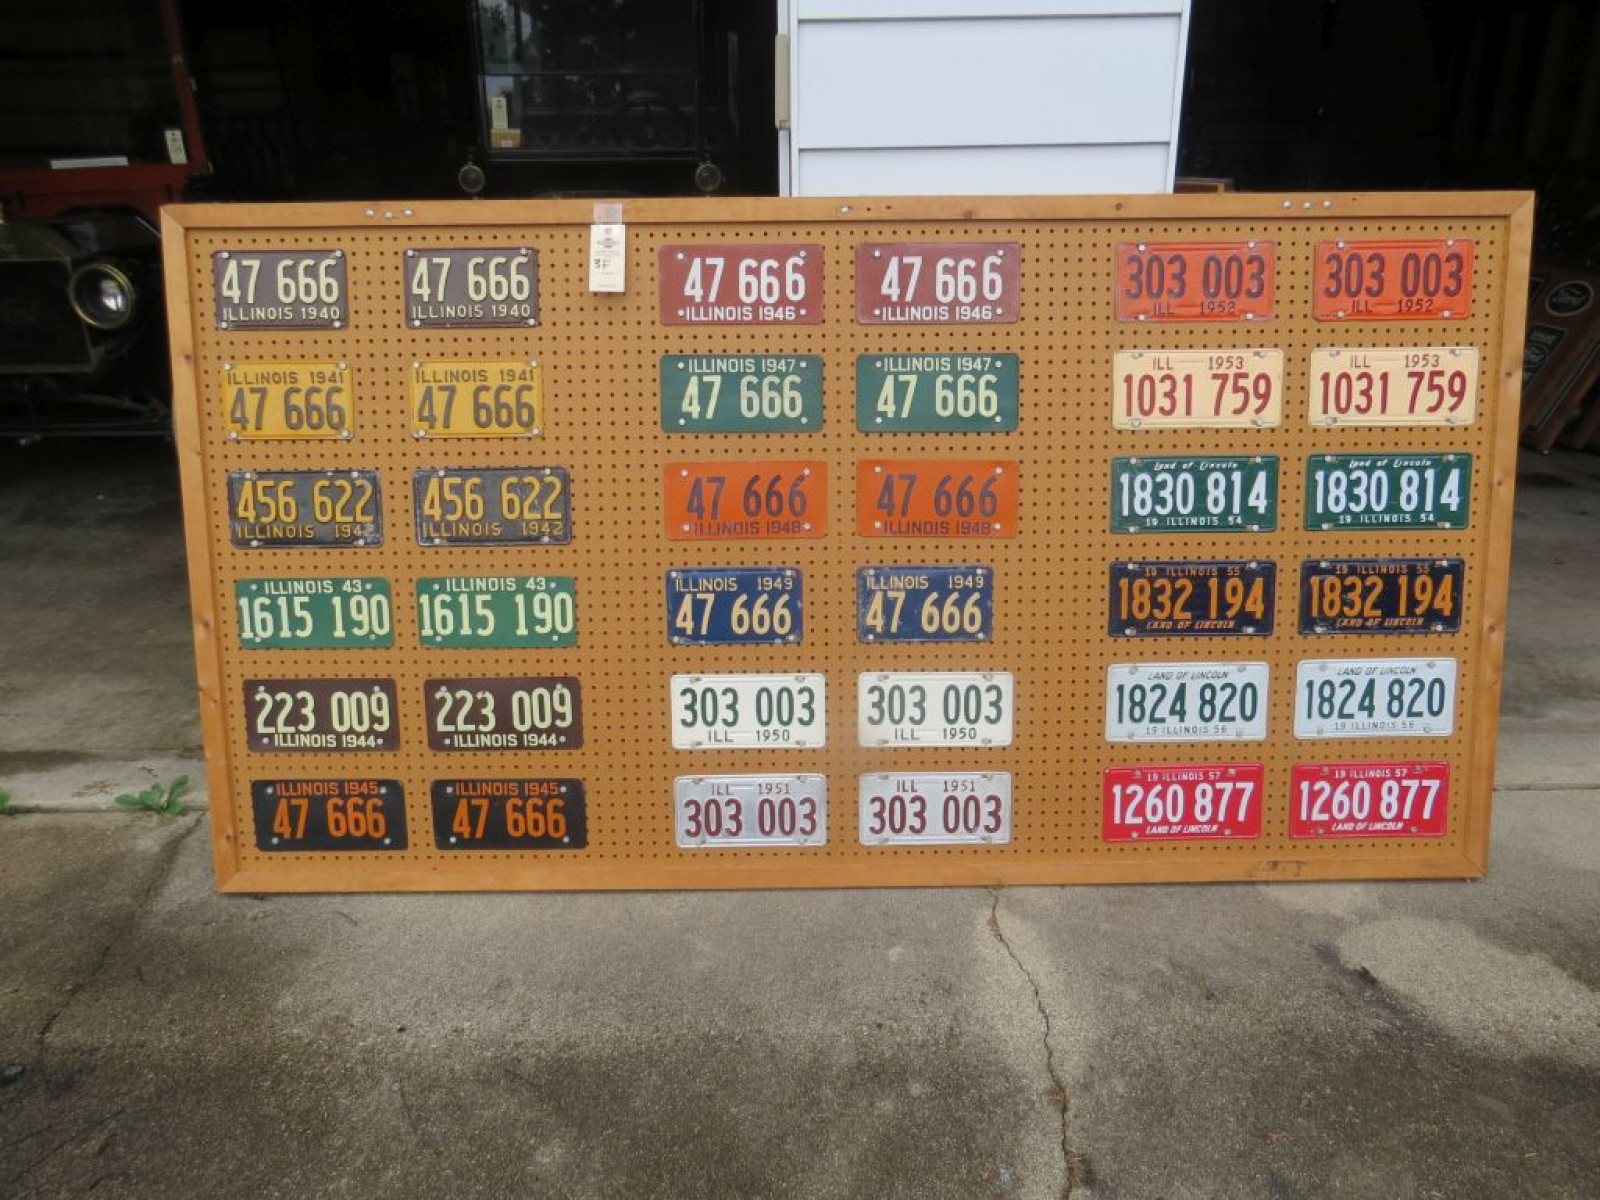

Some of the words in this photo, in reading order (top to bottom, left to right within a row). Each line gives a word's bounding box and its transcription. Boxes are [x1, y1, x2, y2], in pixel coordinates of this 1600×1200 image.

[222, 260, 261, 304] 47
[277, 259, 339, 304] 666
[412, 258, 450, 302] 47
[467, 257, 530, 301] 666
[684, 258, 725, 302] 47
[739, 256, 806, 304] 666
[880, 256, 923, 302] 47
[936, 256, 1002, 303] 666
[1125, 254, 1187, 299] 303
[1202, 254, 1265, 299] 003
[1324, 253, 1385, 297] 303
[1402, 252, 1463, 297] 003
[223, 308, 293, 321] ILLINOIS
[301, 307, 340, 320] 1940
[412, 305, 484, 318] ILLINOIS
[492, 304, 531, 317] 1940
[686, 306, 752, 320] ILLINOIS
[759, 306, 796, 320] 1946
[883, 306, 949, 320] ILLINOIS
[956, 306, 992, 320] 1946
[1154, 302, 1175, 316] ILL
[1200, 301, 1236, 314] 1952
[1352, 300, 1373, 313] ILL
[1398, 299, 1434, 313] 1952
[228, 372, 298, 385] ILLINOIS
[311, 372, 344, 384] 1941
[416, 370, 488, 383] ILLINOIS
[501, 370, 534, 382] 1941
[689, 359, 755, 373] ILLINOIS
[762, 359, 796, 373] 1947
[884, 358, 950, 372] ILLINOIS
[958, 358, 991, 371] 1947
[1153, 356, 1173, 370] ILL
[1209, 356, 1244, 370] 1953
[1351, 355, 1370, 368] ILL
[1405, 354, 1440, 368] 1953
[230, 387, 267, 430] 47
[284, 386, 346, 430] 666
[418, 385, 456, 428] 47
[473, 384, 535, 428] 666
[681, 375, 722, 419] 47
[740, 374, 802, 418] 666
[876, 374, 918, 418] 47
[936, 374, 998, 418] 666
[1124, 374, 1192, 417] 1031
[1211, 372, 1272, 416] 759
[1320, 372, 1389, 414] 1031
[1408, 370, 1467, 414] 759
[238, 480, 297, 523] 456
[314, 480, 374, 523] 622
[424, 477, 484, 521] 456
[502, 477, 562, 520] 622
[687, 476, 725, 520] 47
[743, 475, 806, 517] 666
[876, 474, 917, 517] 47
[934, 475, 998, 517] 666
[1120, 472, 1195, 516] 1830
[1207, 471, 1268, 514] 814
[1315, 470, 1388, 514] 1830
[1400, 469, 1460, 512] 814
[238, 525, 315, 538] ILLINOIS
[423, 523, 500, 537] ILLINOIS
[523, 522, 563, 535] 1942
[695, 522, 760, 536] ILLINOIS
[884, 521, 949, 535] ILLINOIS
[1360, 514, 1411, 523] ILLINOIS
[265, 581, 333, 594] ILLINOIS
[342, 580, 362, 593] 43
[447, 578, 516, 592] ILLINOIS
[526, 577, 546, 590] 43
[675, 578, 738, 592] ILLINOIS
[757, 578, 792, 591] 1949
[867, 576, 929, 590] ILLINOIS
[949, 575, 984, 588] 1949
[1119, 578, 1193, 620] 1832
[1208, 578, 1264, 620] 194
[1310, 575, 1384, 618] 1832
[1398, 574, 1453, 617] 194
[239, 596, 313, 639] 1615
[332, 594, 390, 638] 190
[420, 593, 495, 636] 1615
[515, 592, 573, 636] 190
[675, 594, 715, 635] 47
[731, 593, 791, 635] 666
[866, 591, 906, 634] 47
[921, 592, 982, 634] 666
[254, 691, 316, 733] 223
[331, 691, 390, 732] 009
[435, 690, 496, 732] 223
[512, 687, 573, 732] 009
[680, 687, 739, 727] 303
[756, 686, 815, 727] 003
[867, 684, 926, 726] 303
[943, 684, 1002, 725] 003
[1117, 683, 1187, 724] 1824
[1199, 682, 1258, 723] 820
[1306, 678, 1376, 720] 1824
[1387, 678, 1446, 718] 820
[274, 734, 336, 747] ILLINOIS
[342, 734, 376, 747] 1944
[454, 734, 517, 747] ILLINOIS
[524, 733, 557, 747] 1944
[709, 730, 733, 742] ILL
[756, 730, 790, 742] 1950
[895, 728, 920, 740] ILL
[943, 728, 977, 740] 1950
[276, 782, 338, 796] ILLINOIS
[345, 782, 379, 795] 1945
[455, 782, 519, 796] ILLINOIS
[525, 782, 559, 795] 1945
[712, 784, 733, 795] ILL
[758, 783, 790, 795] 1951
[896, 780, 917, 792] ILL
[944, 780, 975, 792] 1951
[1112, 783, 1184, 824] 1260
[1194, 781, 1254, 822] 877
[1300, 780, 1370, 821] 1260
[1380, 780, 1440, 820] 877
[274, 798, 309, 839] 47
[327, 797, 386, 838] 666
[453, 798, 490, 839] 47
[506, 798, 566, 838] 666
[684, 798, 743, 838] 303
[758, 797, 816, 836] 003
[869, 794, 927, 834] 303
[943, 794, 1002, 834] 003
